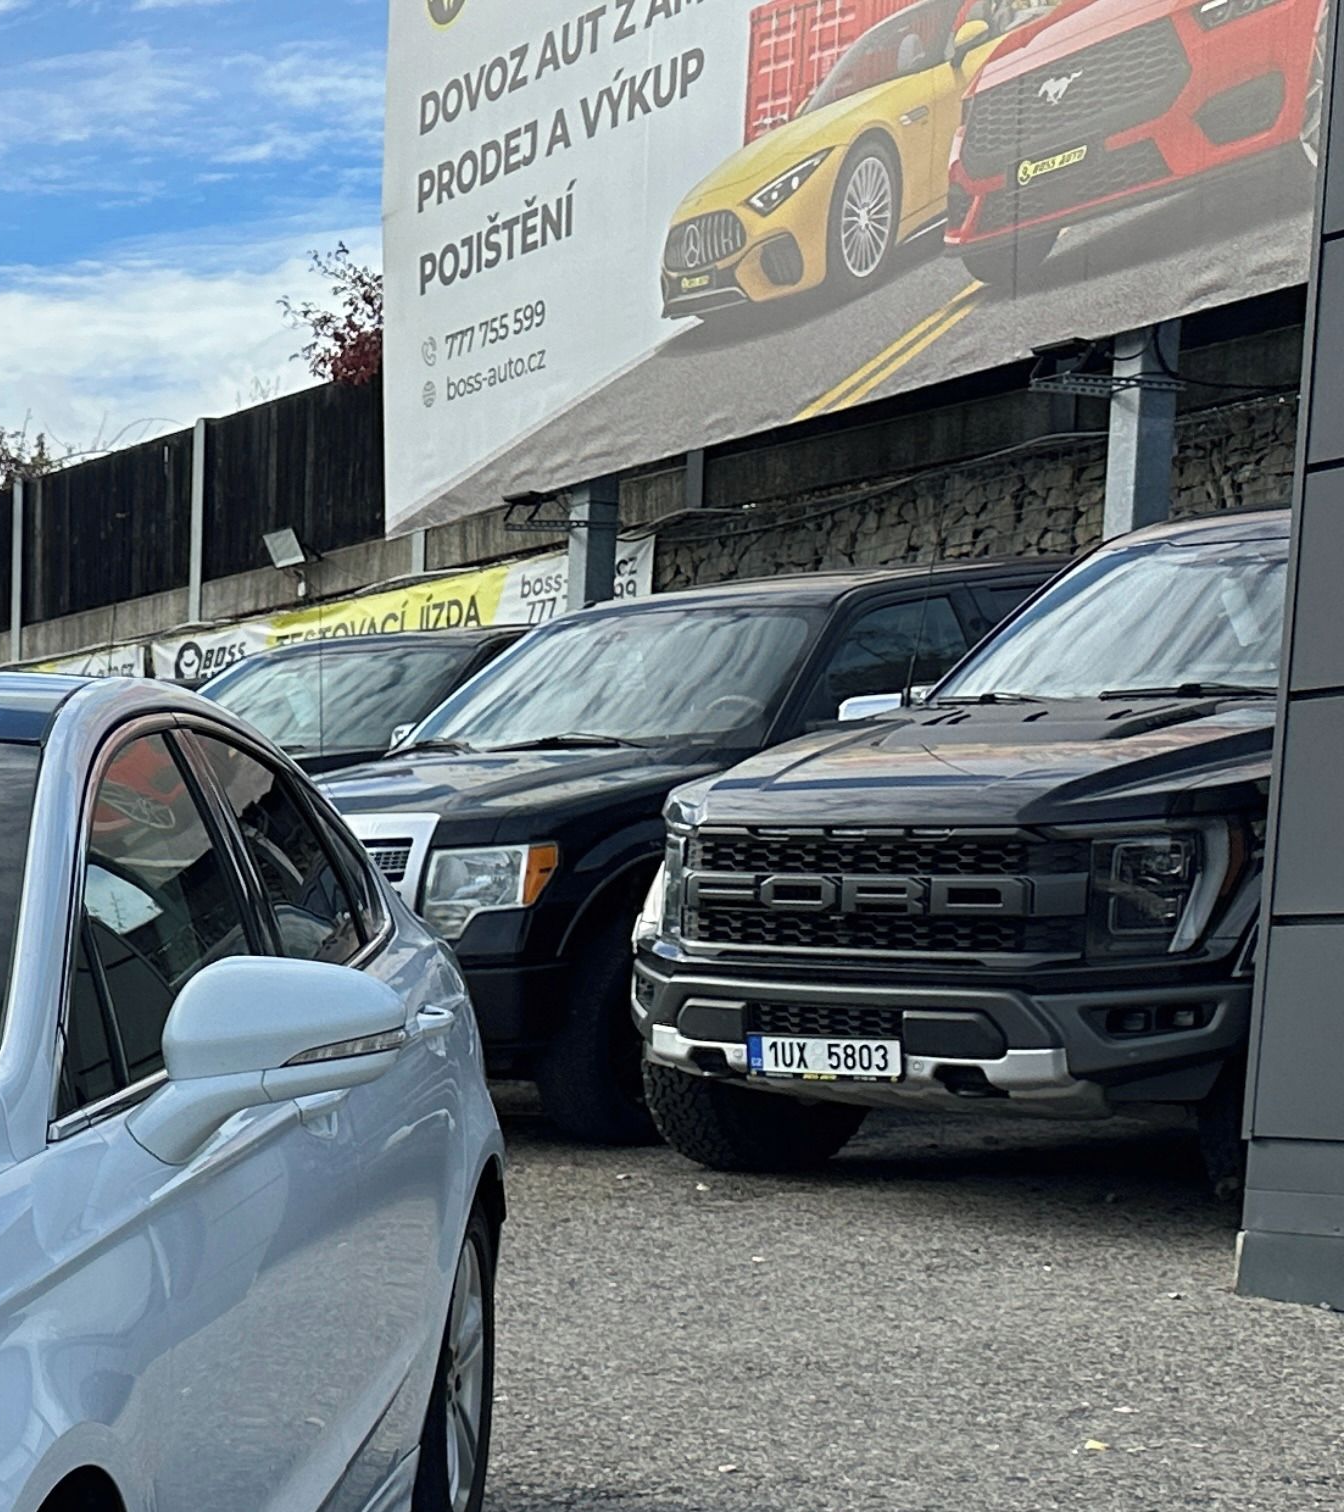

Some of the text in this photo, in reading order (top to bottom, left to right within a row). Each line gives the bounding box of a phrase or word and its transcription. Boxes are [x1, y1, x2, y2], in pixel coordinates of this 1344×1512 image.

[419, 42, 530, 136] DOVOZ
[535, 5, 606, 80] AUT
[417, 48, 705, 213] PRODEJ A VÝKUP
[419, 178, 577, 296] POJIŠTĚNÍ
[444, 300, 546, 361] 777 755 599
[446, 349, 546, 401] boss-auto.cz
[769, 1041, 809, 1069] 1UX
[827, 1043, 889, 1072] 5803
